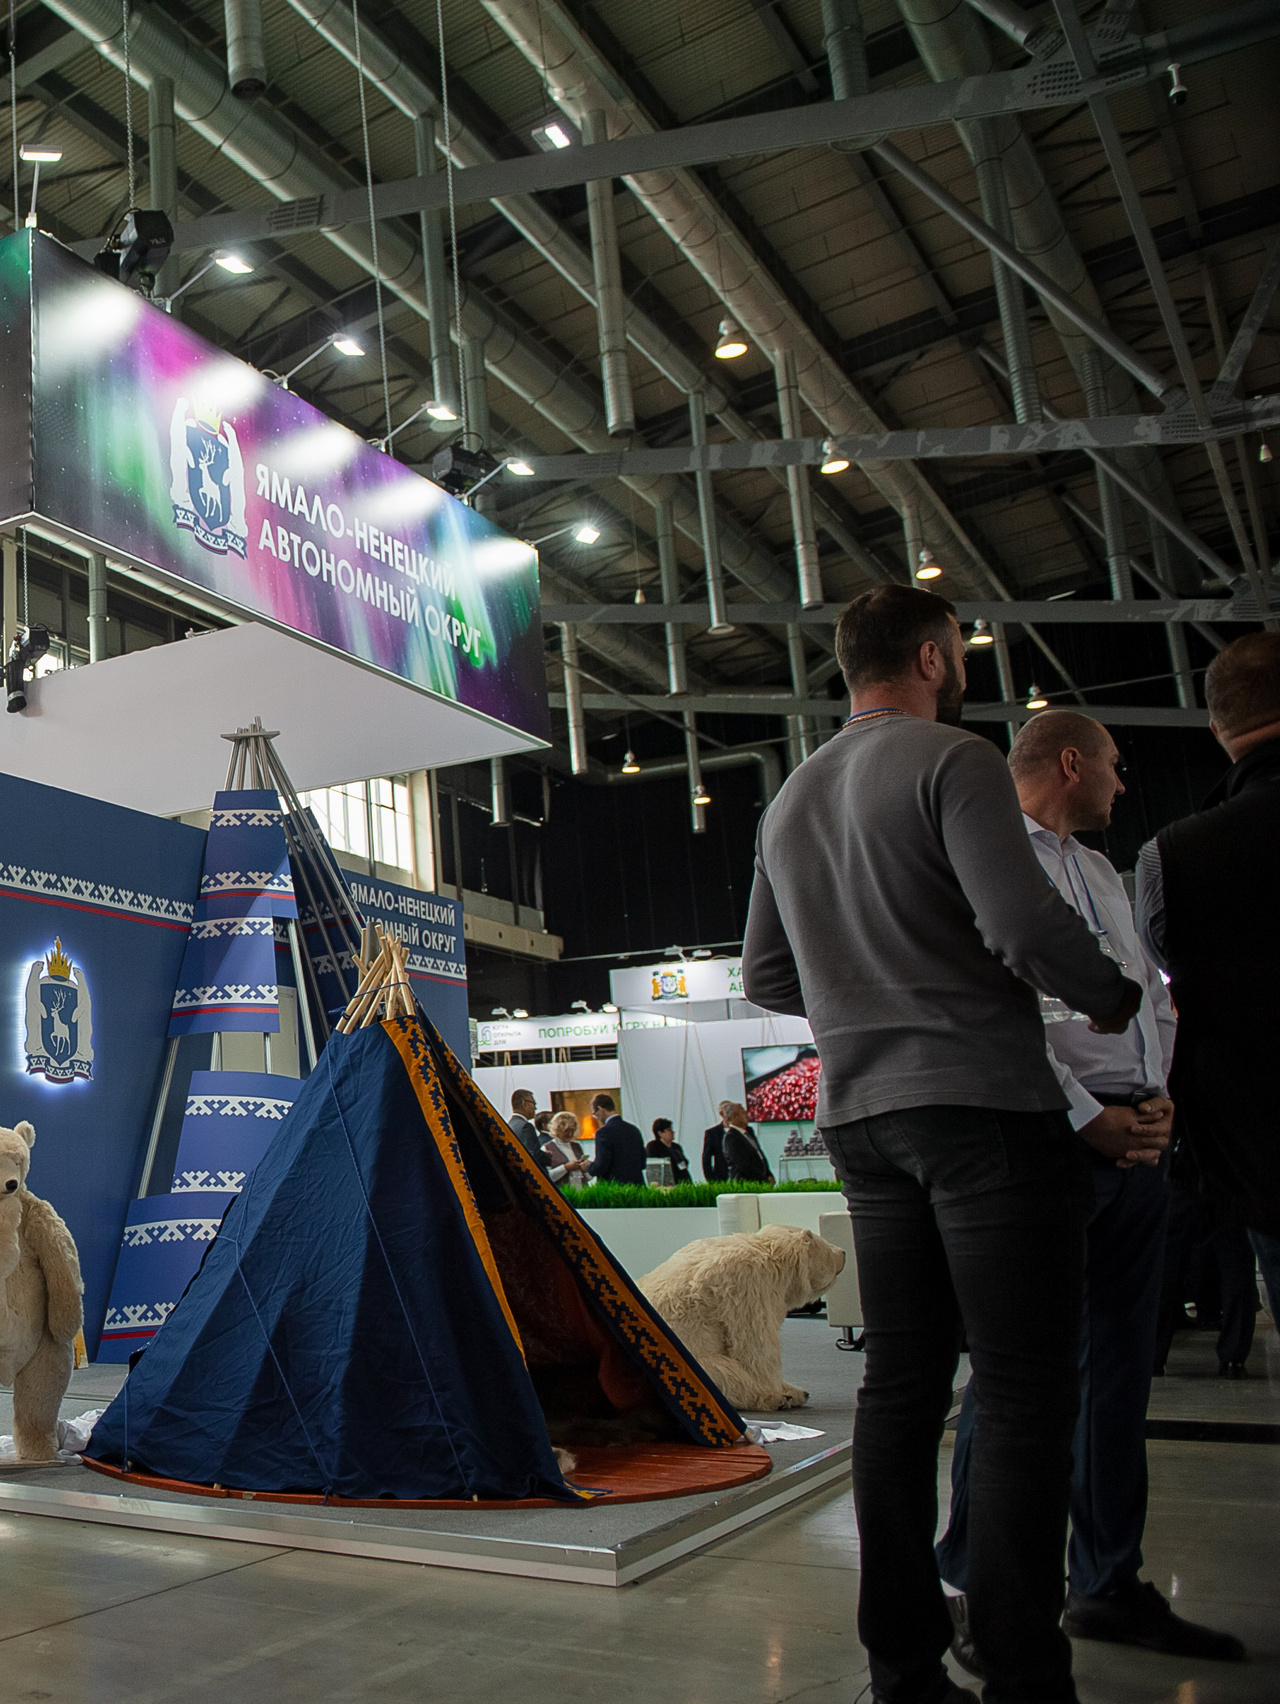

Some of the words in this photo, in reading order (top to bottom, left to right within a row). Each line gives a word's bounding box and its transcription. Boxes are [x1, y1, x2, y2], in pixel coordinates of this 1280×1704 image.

[256, 463, 456, 601] ЯМАЛО-НЕНЕЦКИЙ
[258, 518, 419, 628] АВТОНОМНЫЙ
[424, 604, 481, 658] ОКРУГ
[350, 882, 456, 927] ЯМАЛО-НЕНЕЦКИЙ
[422, 929, 457, 954] ОКРУГ
